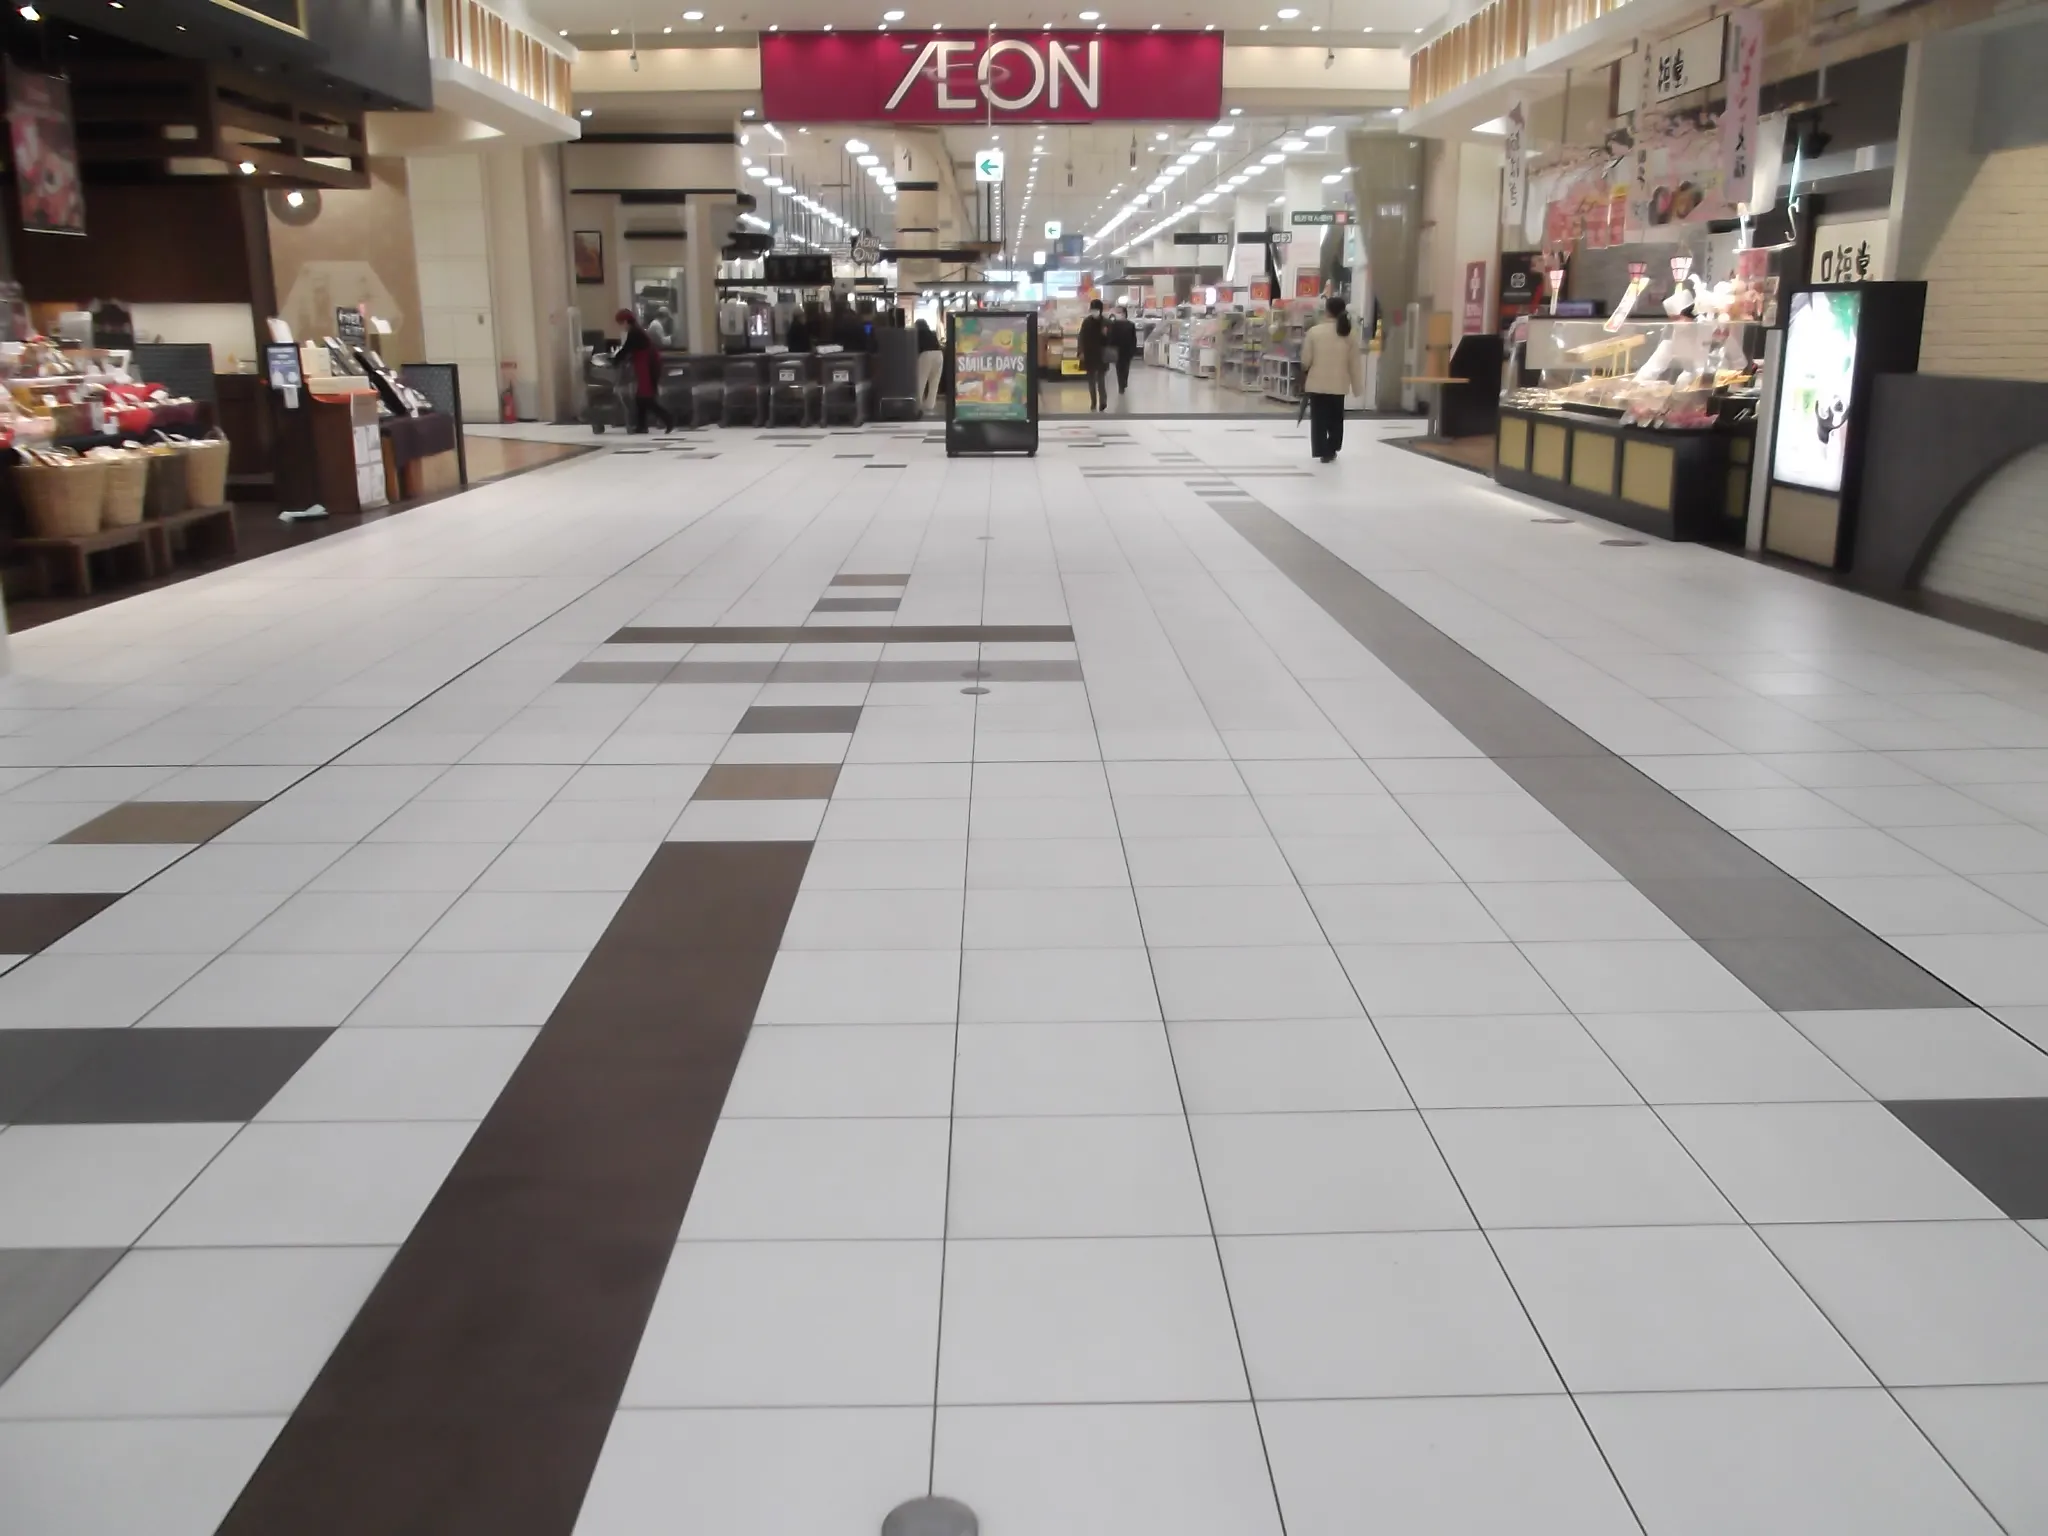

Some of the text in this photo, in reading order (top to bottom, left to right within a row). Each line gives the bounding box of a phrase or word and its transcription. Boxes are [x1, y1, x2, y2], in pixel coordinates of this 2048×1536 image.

[1821, 240, 1871, 283] 口福堂
[958, 355, 1025, 373] SMILE DAYS
